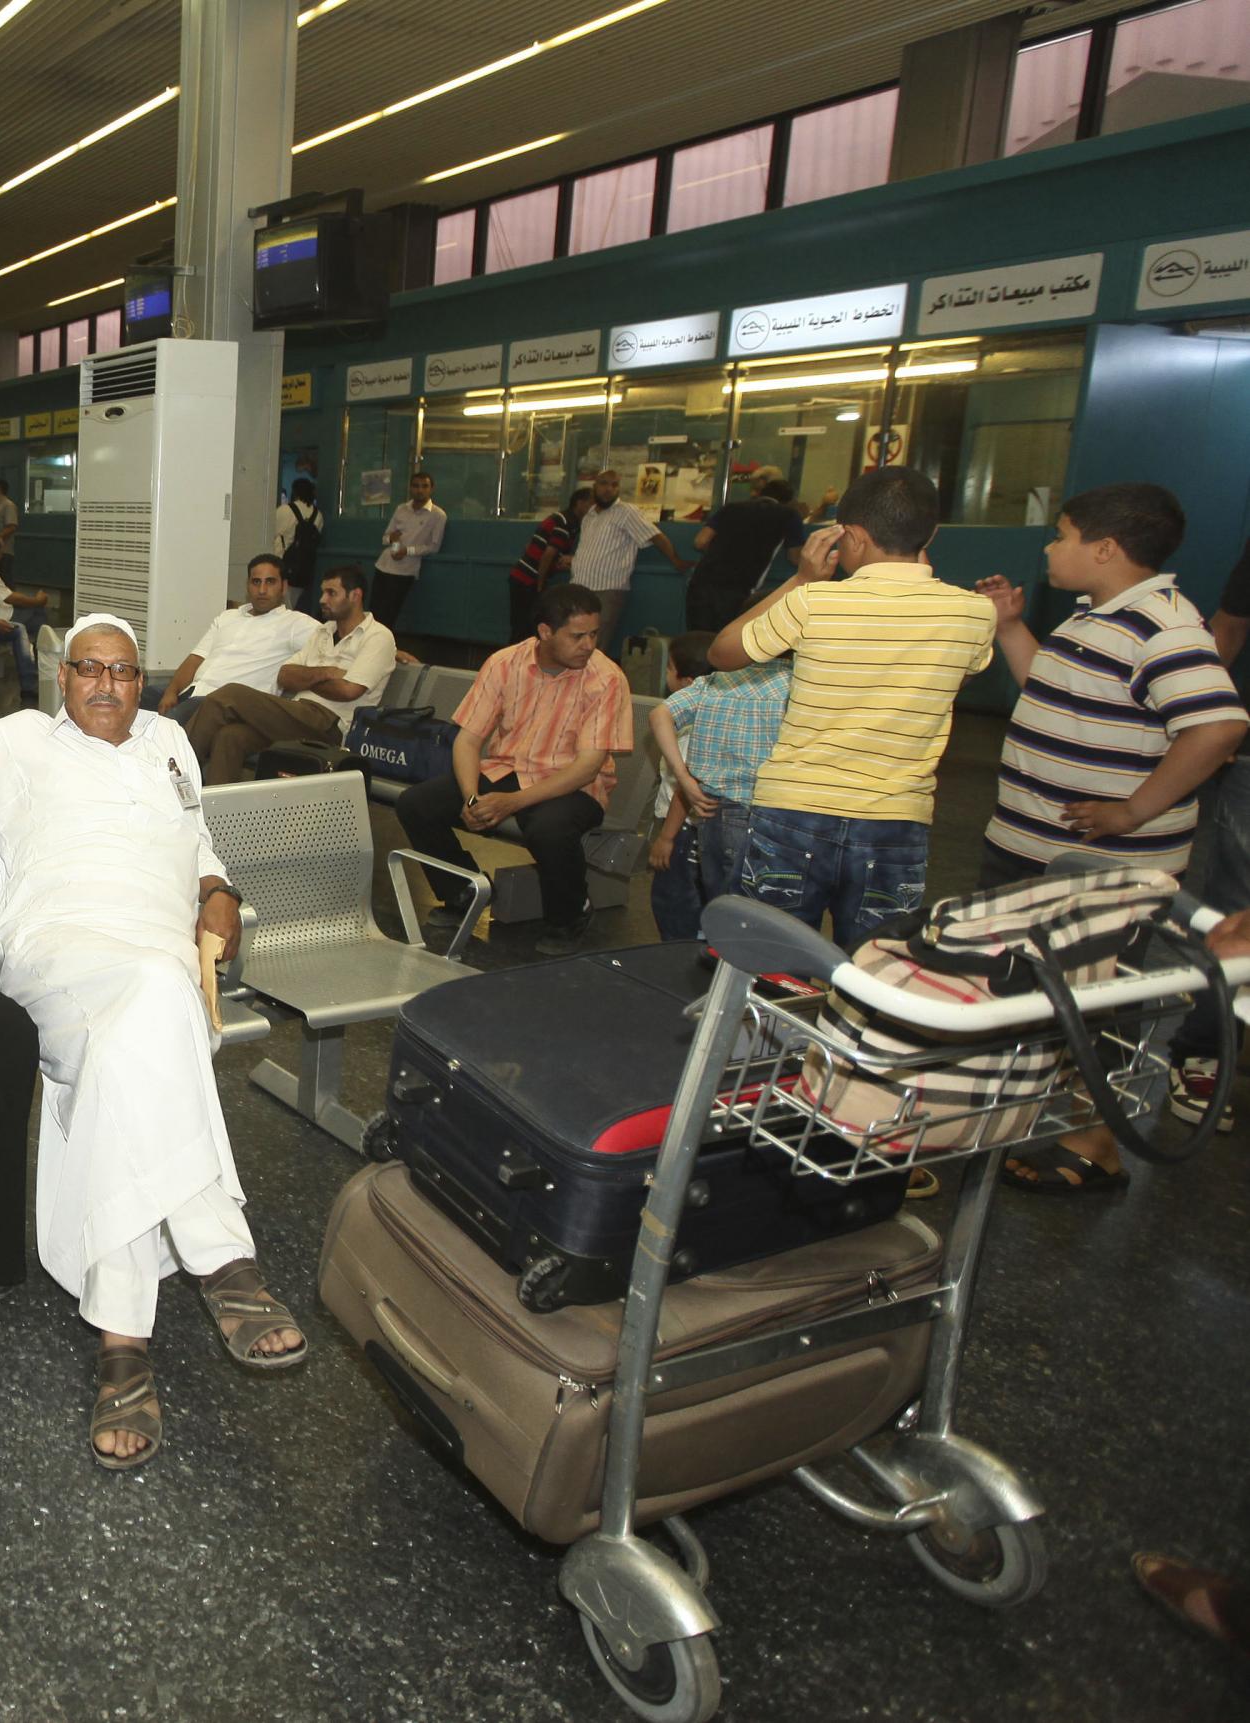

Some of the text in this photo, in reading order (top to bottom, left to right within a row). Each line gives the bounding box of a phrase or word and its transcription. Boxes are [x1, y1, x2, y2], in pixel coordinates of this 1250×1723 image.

[927, 274, 1091, 315] مكتب مبيعات التذاكر
[771, 302, 900, 336] الخطوط الجوية الليبية
[687, 329, 716, 345] الخطوط
[543, 349, 573, 365] مبيعات
[575, 343, 595, 362] مكتب
[360, 742, 407, 766] OMEGA
